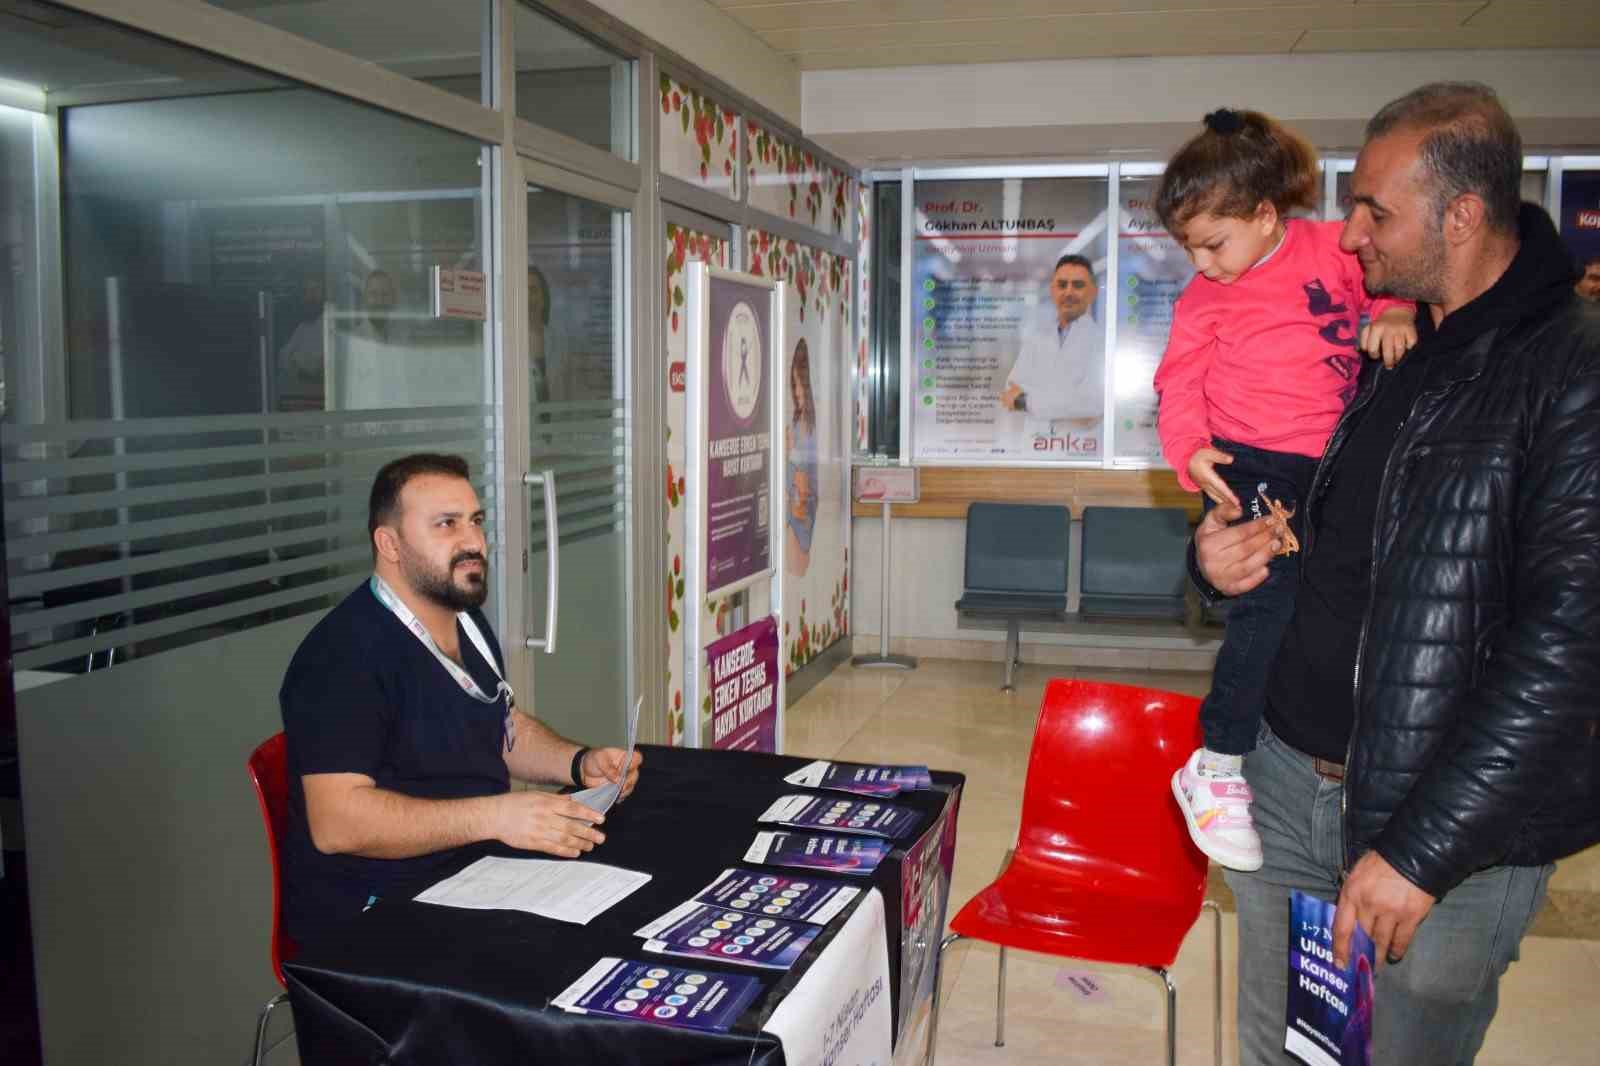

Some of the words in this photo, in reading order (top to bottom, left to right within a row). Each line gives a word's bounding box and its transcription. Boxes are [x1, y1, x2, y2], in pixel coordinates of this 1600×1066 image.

[923, 200, 958, 214] Prof.
[961, 200, 983, 213] Dr.
[924, 218, 977, 232] Gökhan
[981, 218, 1056, 232] ALTUNBAŞ
[1033, 429, 1097, 452] anka
[714, 639, 755, 684] KANSERDE
[714, 674, 741, 714] ERKEN
[714, 704, 738, 744] HAYAT
[738, 683, 774, 727] KURTARIR
[1300, 954, 1350, 994] Kanser
[851, 975, 884, 1032] Haftası
[1299, 974, 1349, 1017] Haftası
